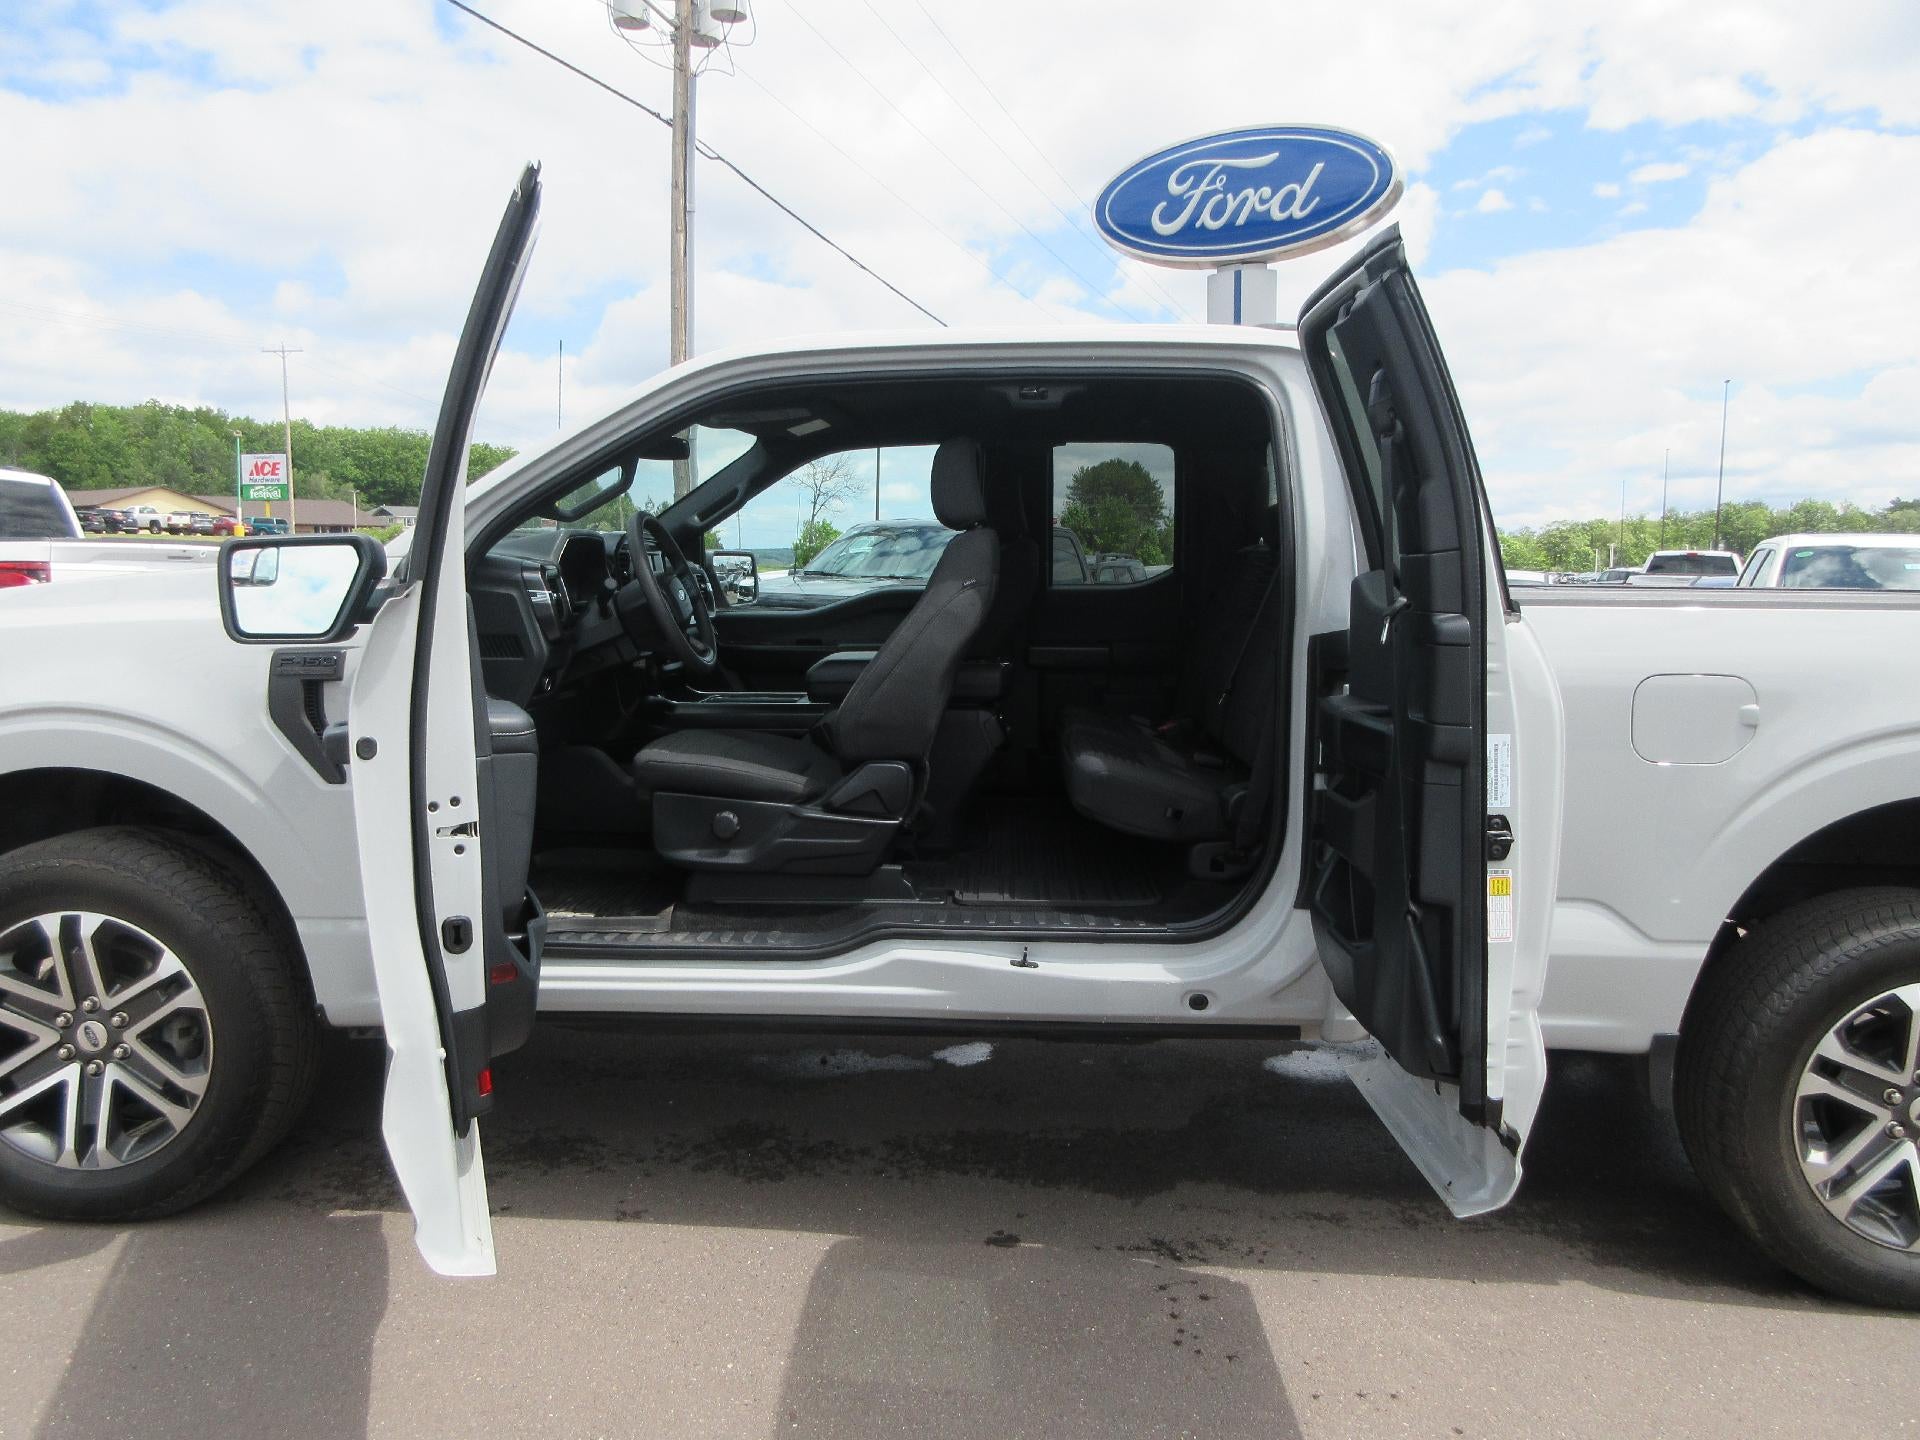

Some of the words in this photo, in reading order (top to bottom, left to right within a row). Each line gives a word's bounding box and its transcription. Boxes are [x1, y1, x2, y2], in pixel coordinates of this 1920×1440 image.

[1151, 151, 1325, 236] Ford
[249, 460, 281, 477] ACE
[250, 487, 281, 499] festival
[280, 655, 337, 667] F-150
